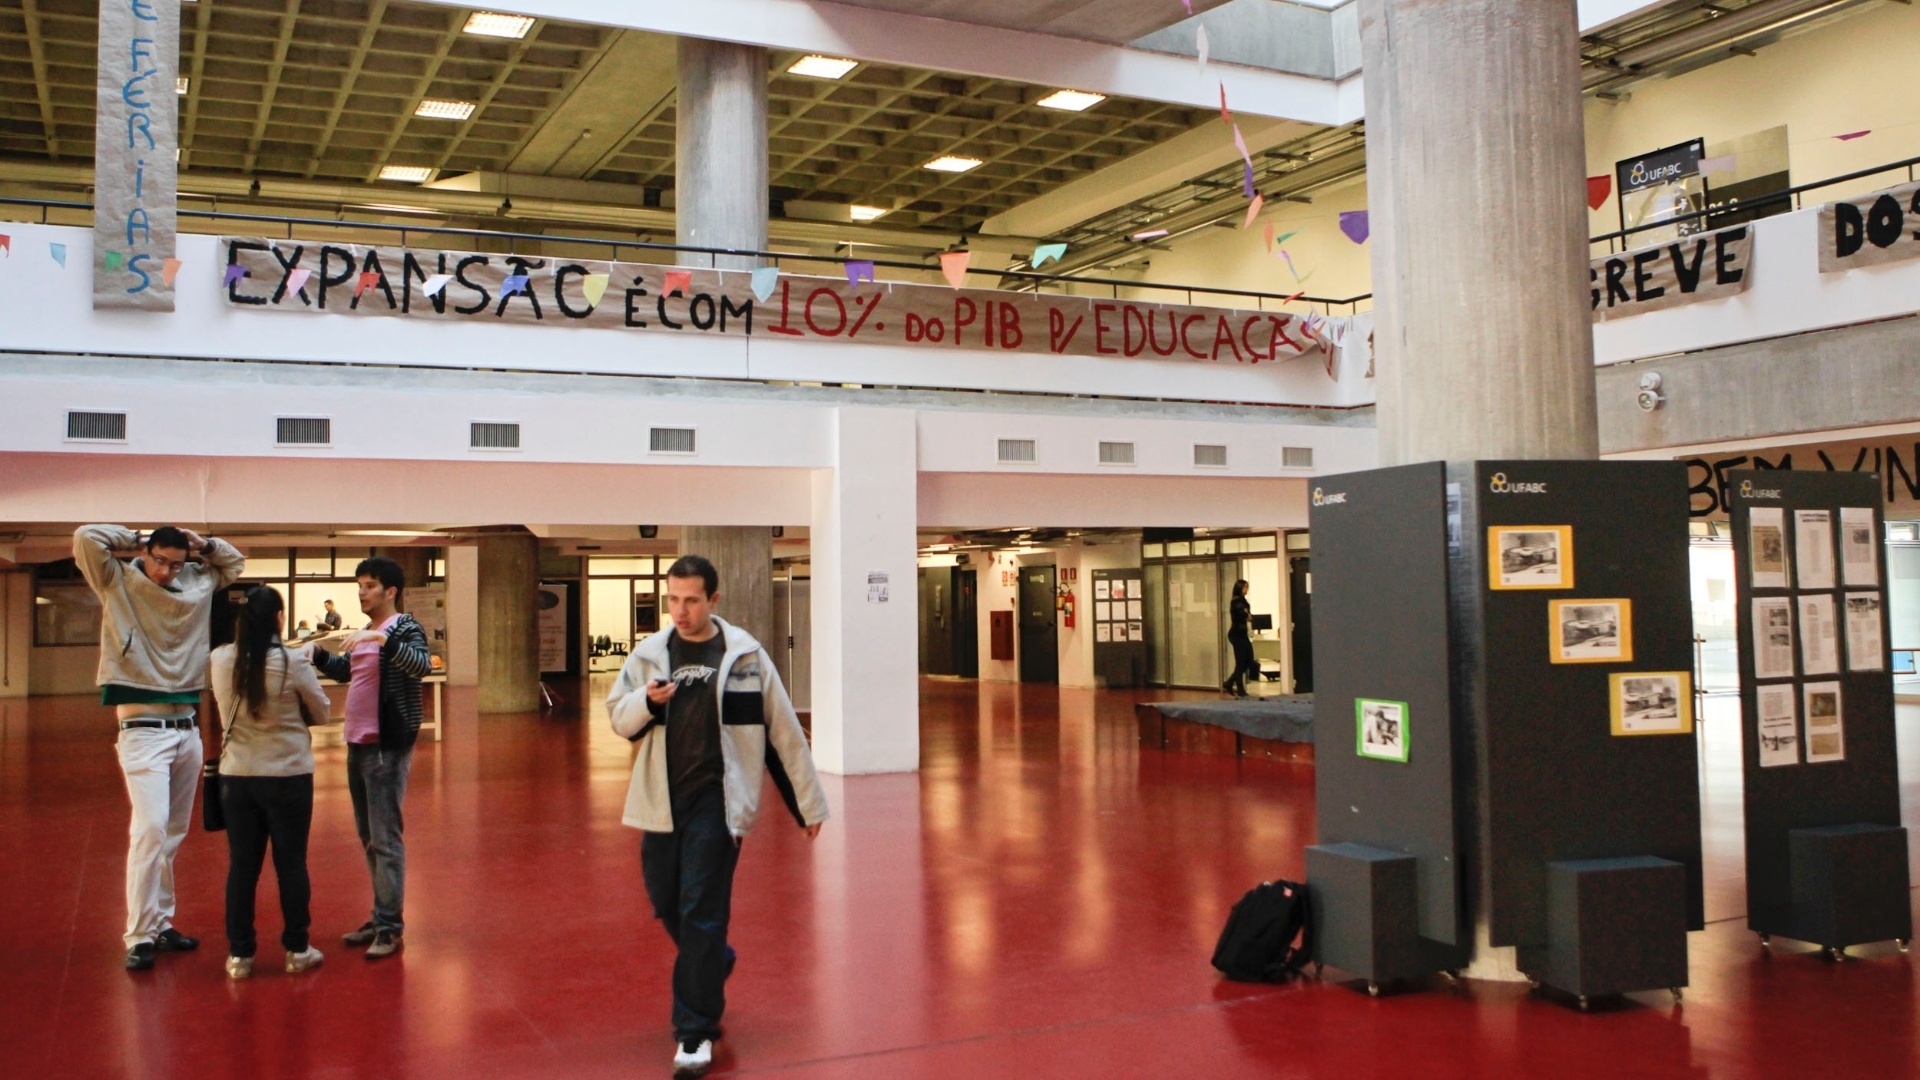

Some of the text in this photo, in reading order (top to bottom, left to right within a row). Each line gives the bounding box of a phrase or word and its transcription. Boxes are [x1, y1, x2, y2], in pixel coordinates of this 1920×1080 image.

[227, 240, 596, 320] EXPANSÃO
[625, 276, 647, 328] É
[658, 290, 753, 335] COM
[767, 280, 884, 338] 10%
[955, 296, 1023, 349] PIB
[1511, 482, 1547, 493] UFABC
